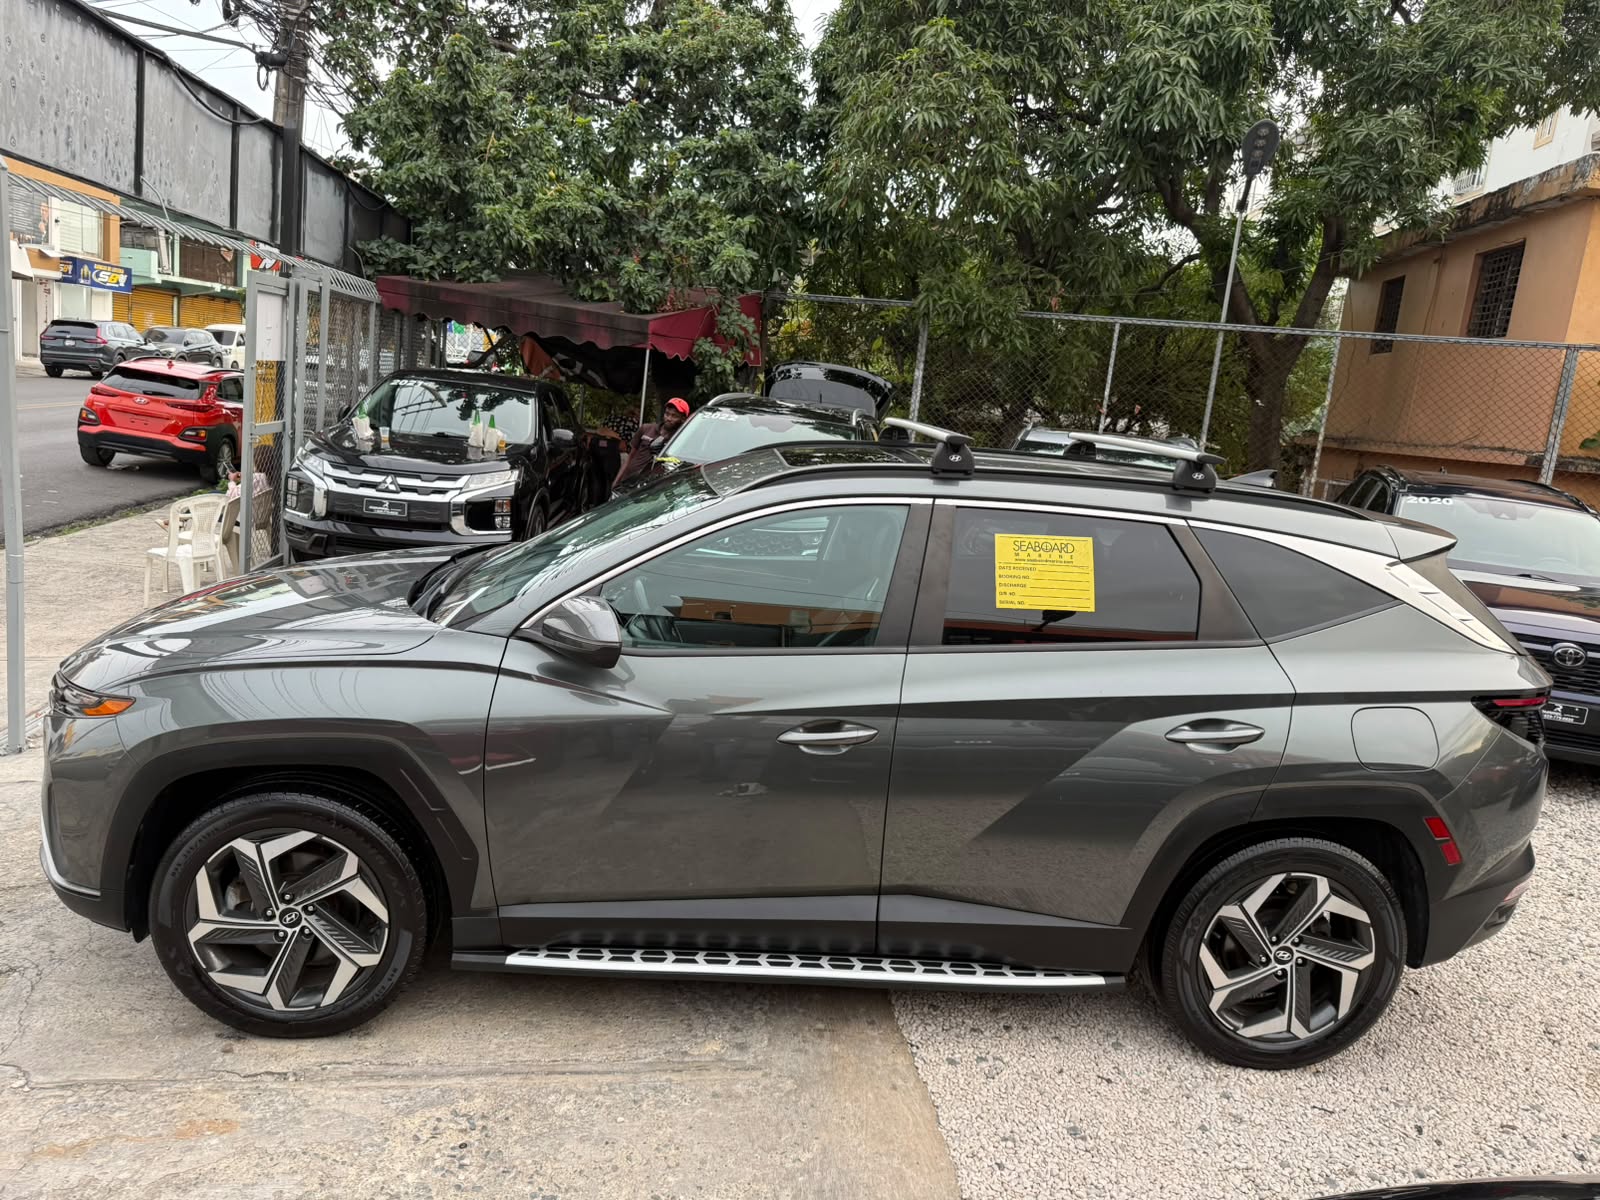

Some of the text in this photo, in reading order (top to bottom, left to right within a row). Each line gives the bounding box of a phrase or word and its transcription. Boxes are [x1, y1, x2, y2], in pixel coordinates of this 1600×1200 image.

[704, 412, 736, 421] 2022
[1406, 496, 1453, 505] 2020
[1013, 540, 1075, 554] SEABOARD
